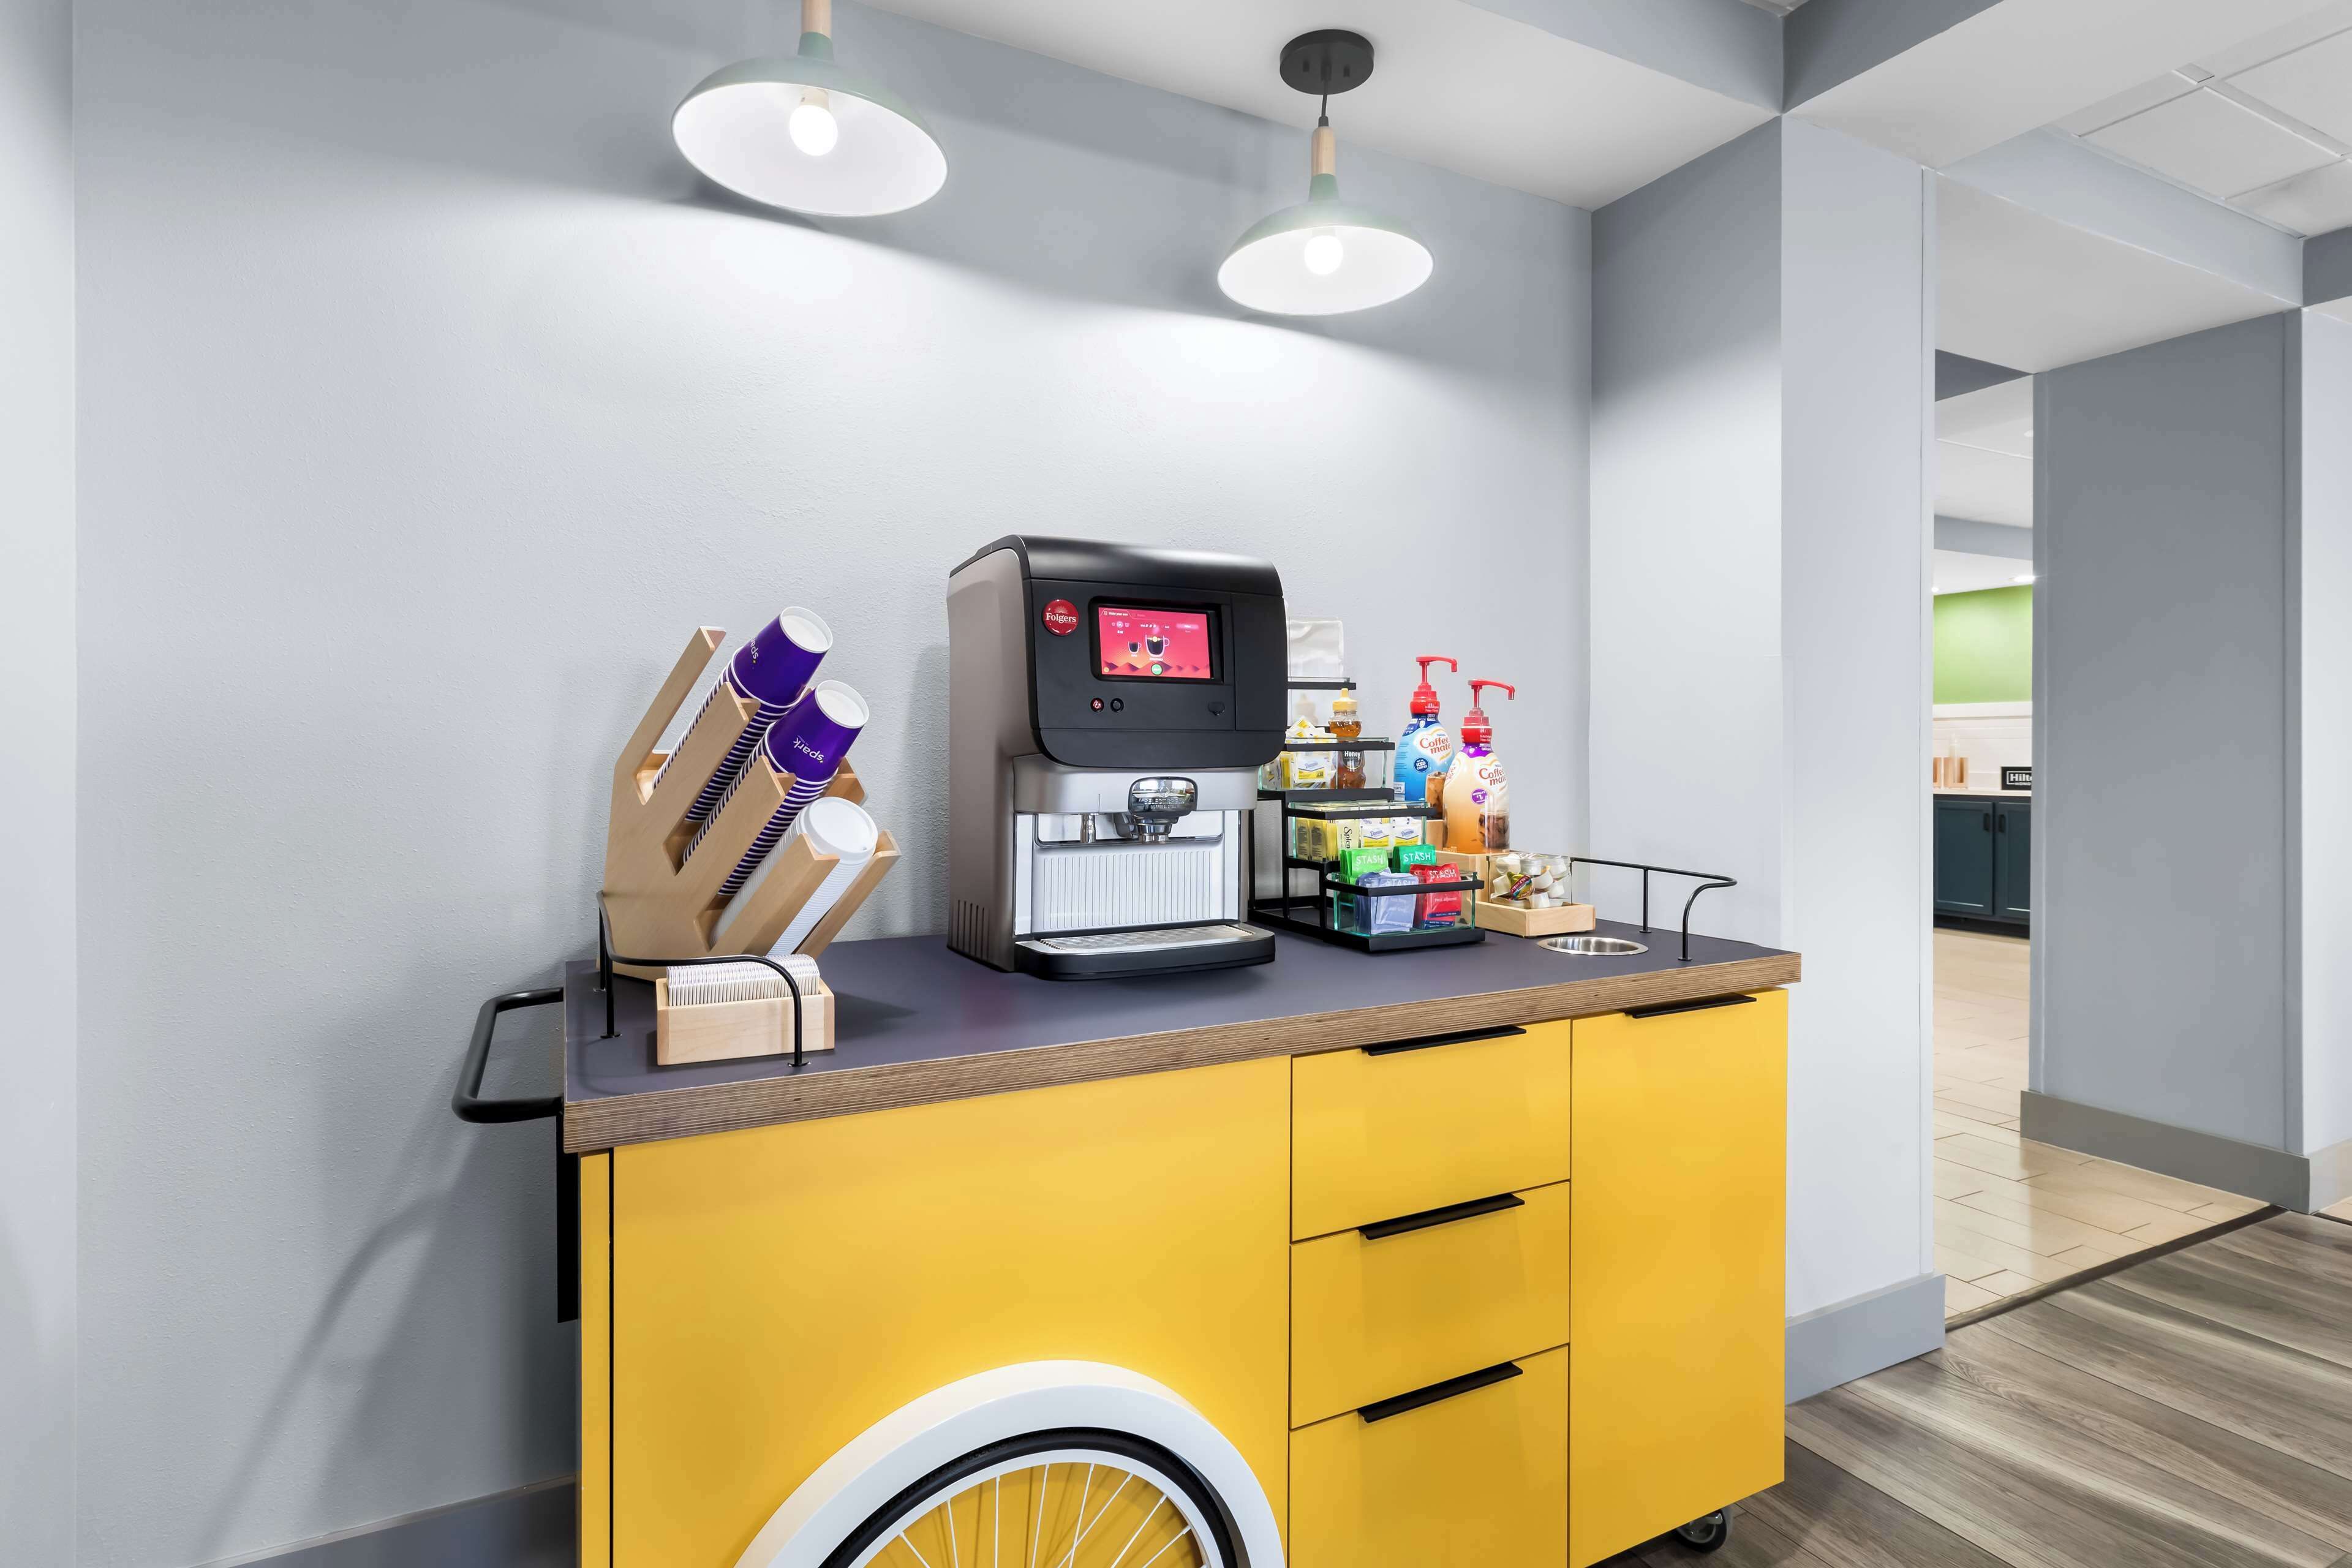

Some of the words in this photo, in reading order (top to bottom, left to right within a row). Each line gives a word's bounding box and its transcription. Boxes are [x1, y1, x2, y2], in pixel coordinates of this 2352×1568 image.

[1046, 612, 1076, 624] Folgers
[793, 736, 824, 761] spark
[1419, 737, 1449, 749] Coffee
[1430, 743, 1451, 755] mate
[1344, 750, 1360, 760] Honey
[1356, 854, 1384, 865] STASH
[1403, 852, 1431, 862] STASH
[1429, 869, 1457, 880] STASH
